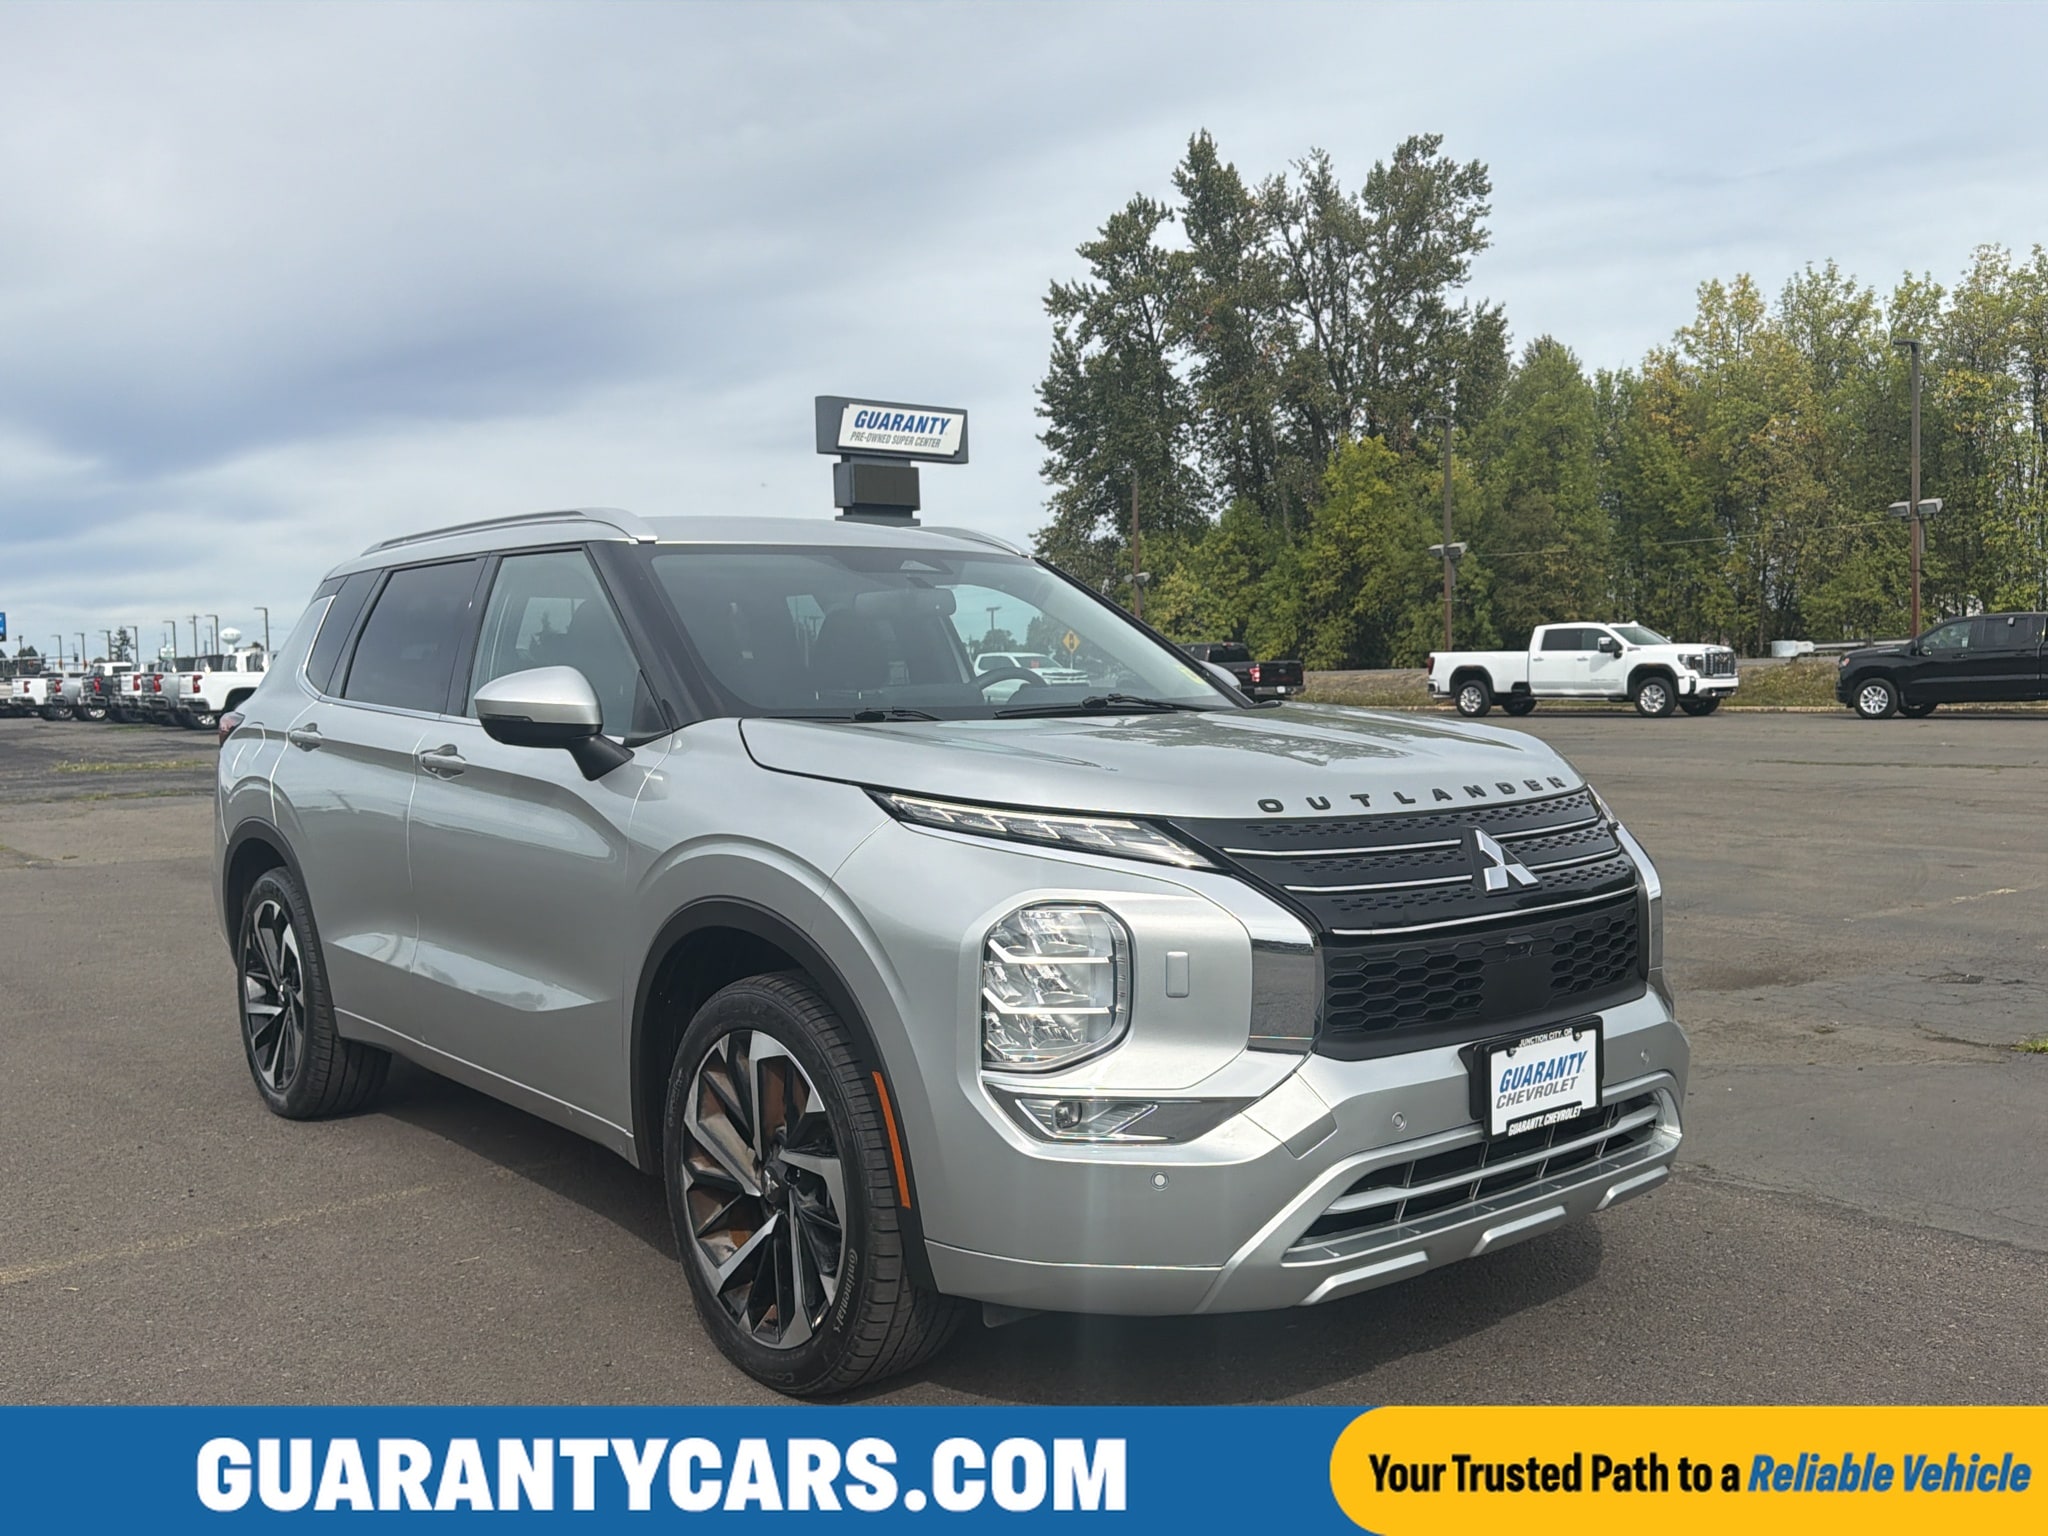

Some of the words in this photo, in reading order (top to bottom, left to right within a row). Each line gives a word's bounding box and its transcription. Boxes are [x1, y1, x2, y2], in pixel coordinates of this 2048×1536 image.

[854, 409, 951, 435] GUARANTY
[849, 431, 891, 444] PRE-OWNED
[891, 434, 914, 446] SUPER
[914, 437, 941, 448] CENTER
[1257, 776, 1567, 813] OUTLANDER
[1499, 1050, 1588, 1093] GUARANTY
[1496, 1076, 1579, 1109] CHEVROLET
[1544, 1105, 1582, 1126] CHEVROLET
[836, 1248, 858, 1326] Continental
